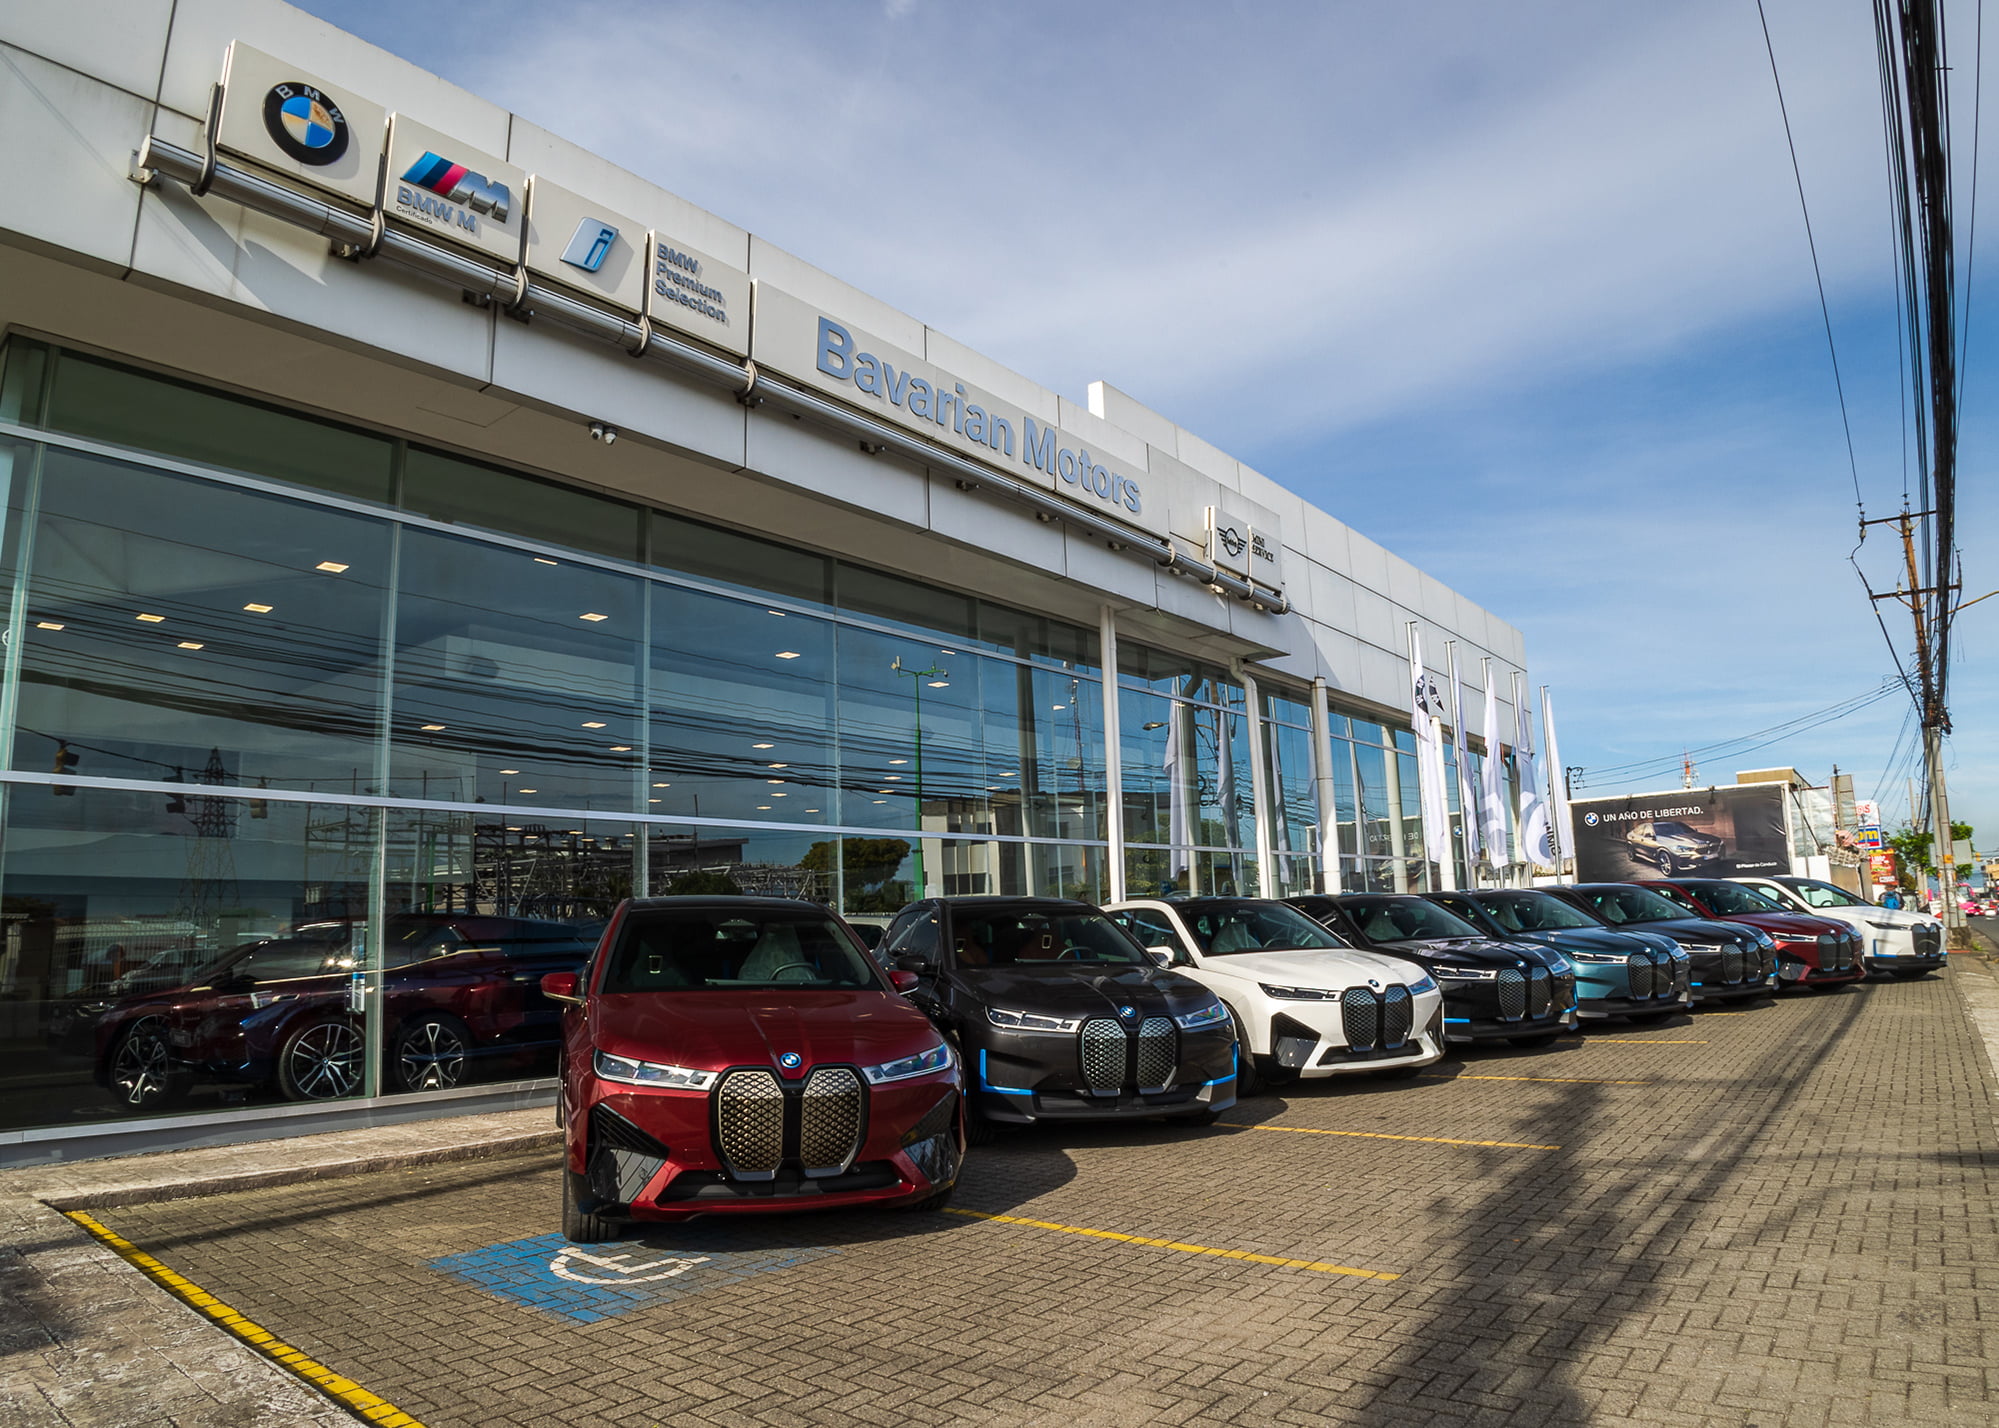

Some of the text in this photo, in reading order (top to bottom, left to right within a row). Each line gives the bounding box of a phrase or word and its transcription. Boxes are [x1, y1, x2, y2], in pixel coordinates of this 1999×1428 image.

[274, 84, 345, 124] BMW
[396, 204, 433, 225] Certificado
[397, 185, 477, 233] BMW M
[656, 243, 699, 274] BMW
[655, 261, 724, 304] Premium
[655, 279, 727, 322] Selection
[816, 315, 1142, 513] Bavarian Motors
[1603, 806, 1704, 822] UN AÑO DE LIBERTAD.
